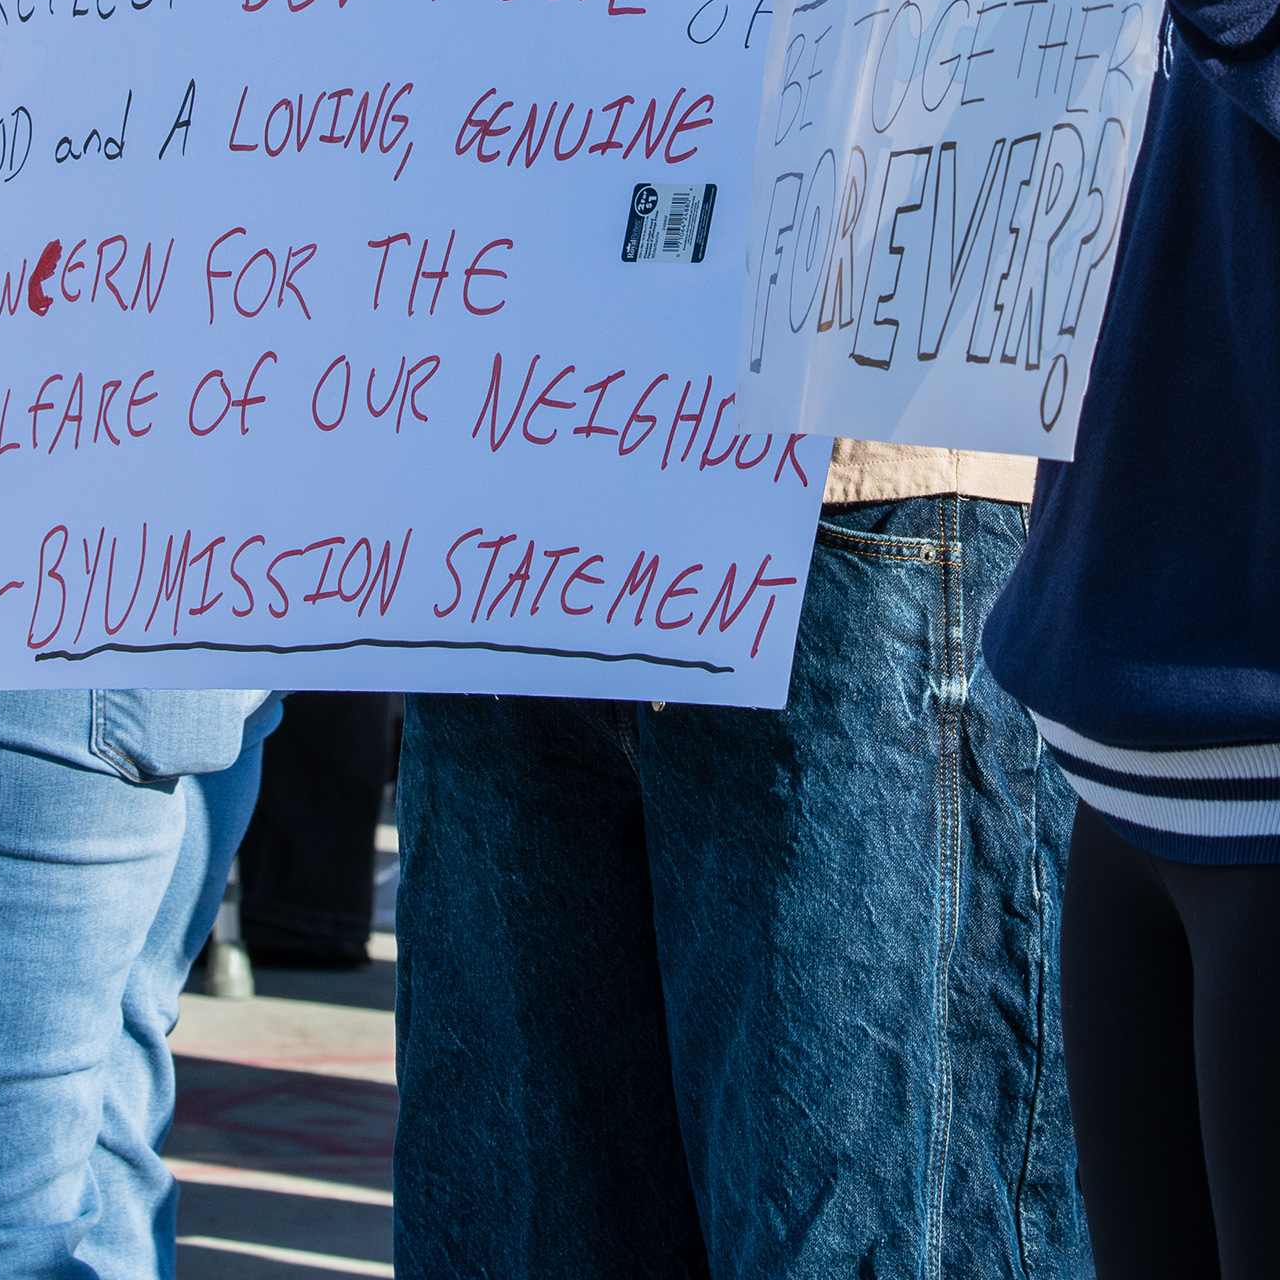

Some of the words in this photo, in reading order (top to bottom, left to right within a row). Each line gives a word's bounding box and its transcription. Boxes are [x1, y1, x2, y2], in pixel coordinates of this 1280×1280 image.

[53, 88, 133, 164] and
[158, 77, 197, 162] A
[228, 80, 415, 183] LOVING,
[454, 87, 716, 170] GENUINE
[774, 23, 834, 148] BE
[205, 226, 318, 326] FOR
[367, 228, 515, 318] THE
[311, 353, 442, 435] OUR
[433, 527, 798, 660] STATEMENT
